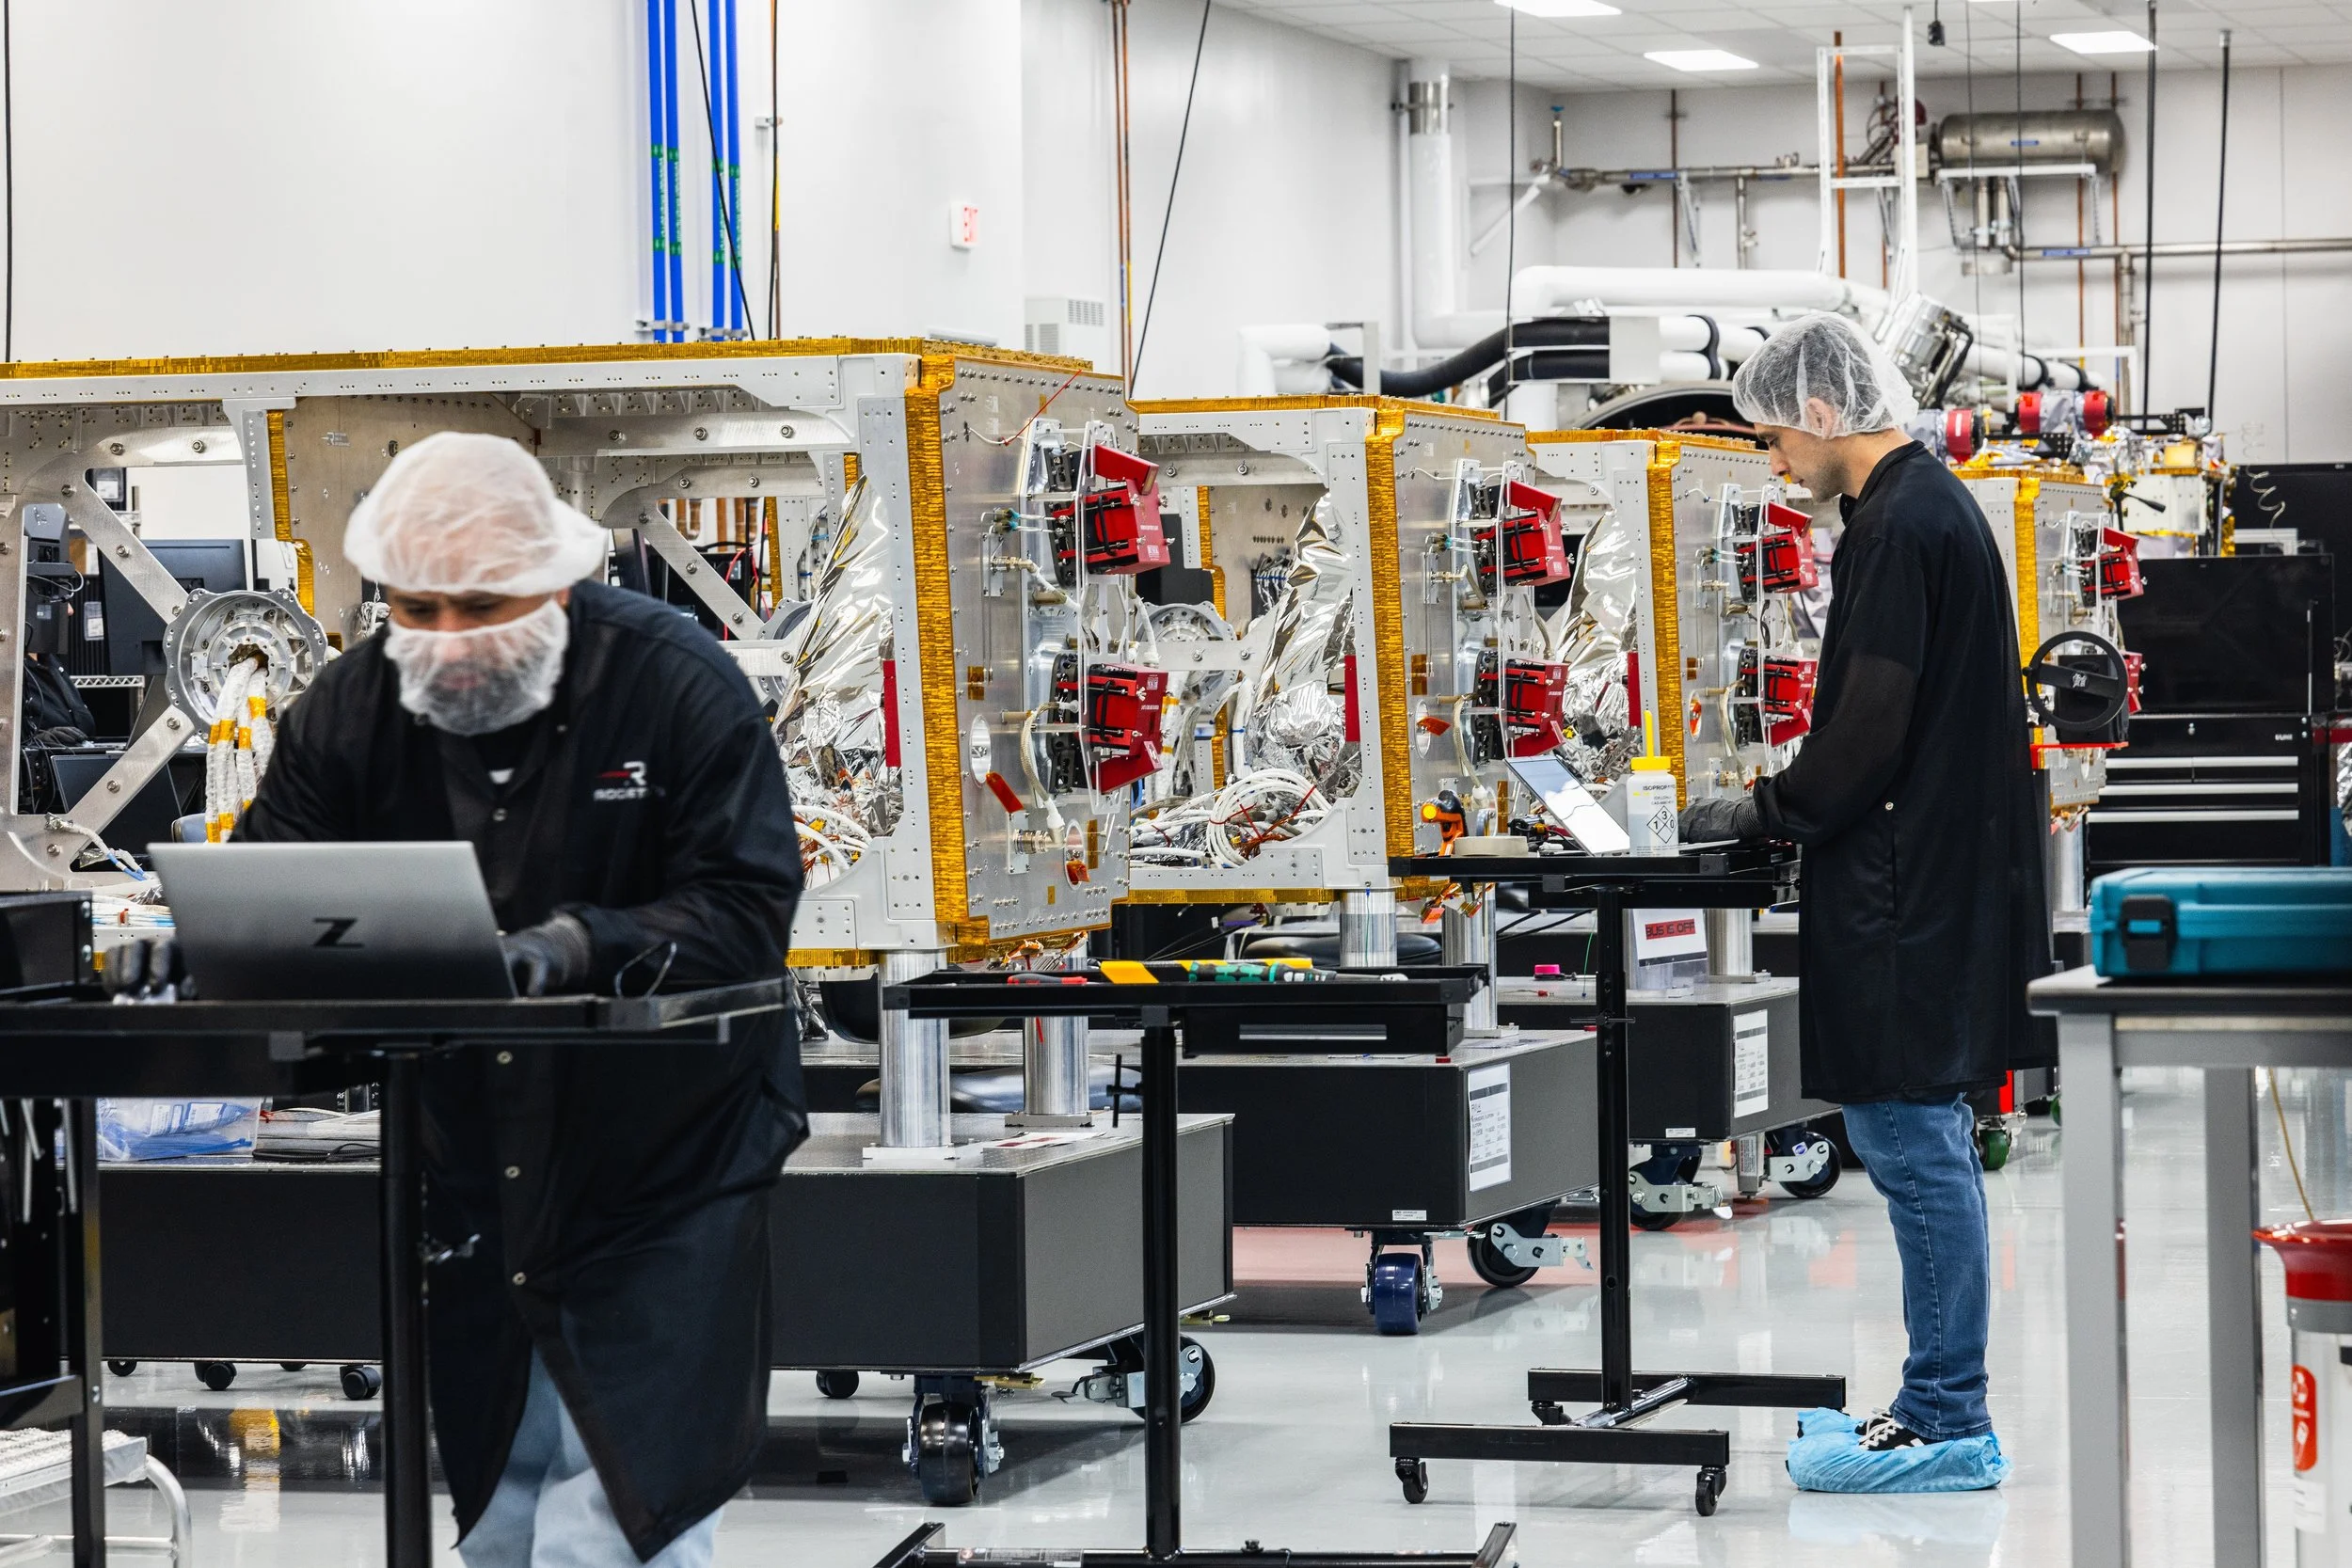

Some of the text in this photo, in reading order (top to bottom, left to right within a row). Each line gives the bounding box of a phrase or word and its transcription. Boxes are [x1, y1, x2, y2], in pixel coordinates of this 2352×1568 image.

[1661, 811, 1668, 820] 3
[1669, 819, 1675, 829] 0
[313, 917, 365, 948] Z
[1645, 925, 1665, 938] BUS
[1677, 921, 1694, 933] OFF
